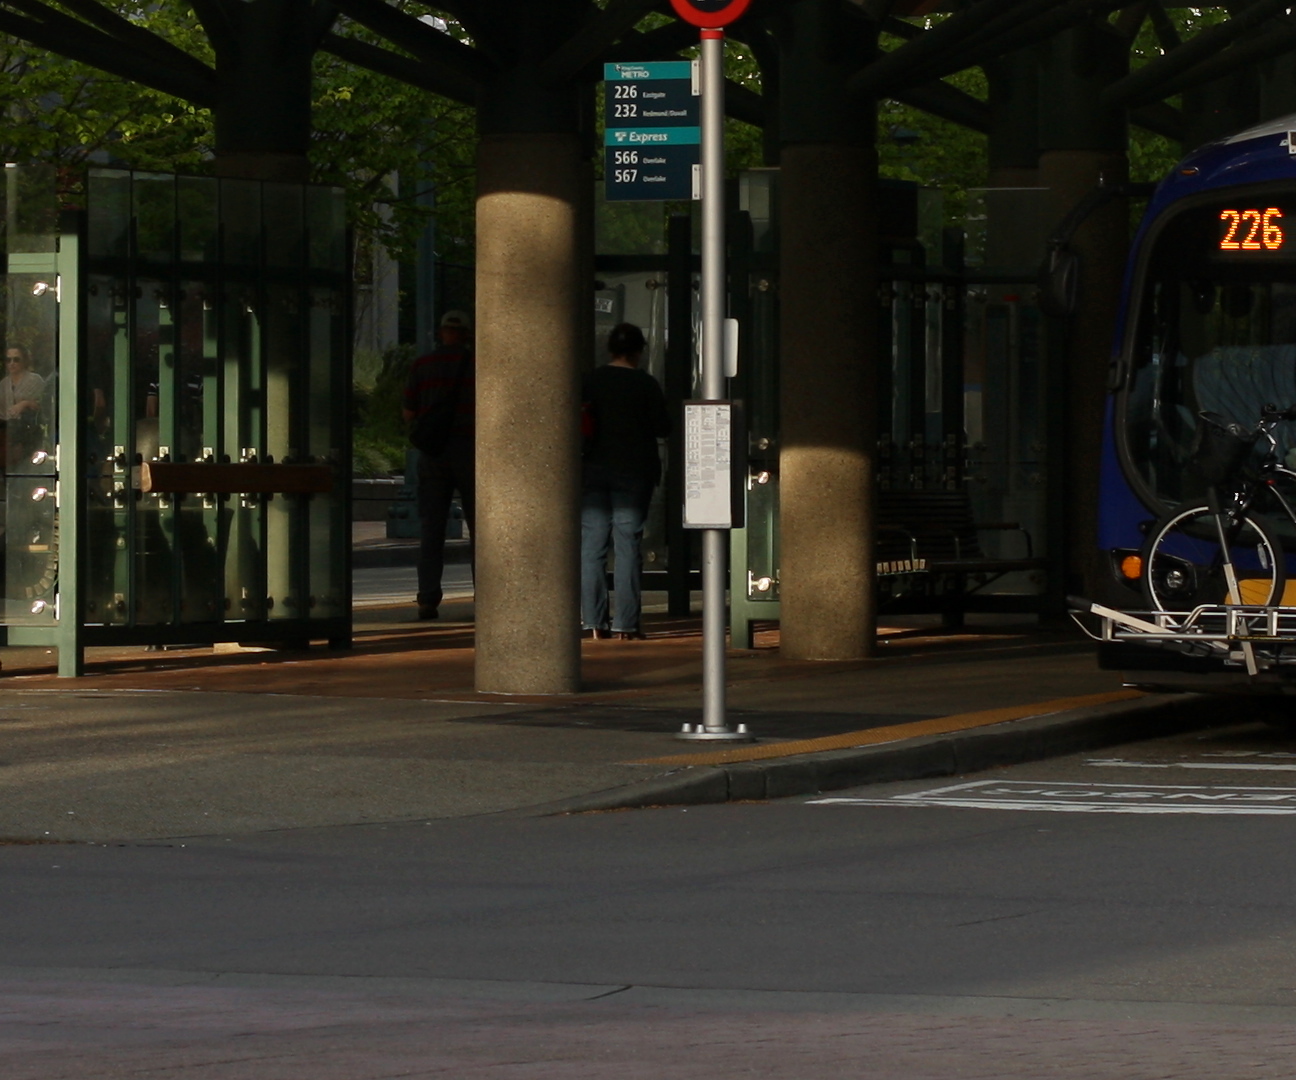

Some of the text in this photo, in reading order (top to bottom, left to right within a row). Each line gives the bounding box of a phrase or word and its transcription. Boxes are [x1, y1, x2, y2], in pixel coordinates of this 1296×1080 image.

[621, 70, 650, 79] METRO
[614, 85, 638, 99] 226
[614, 104, 638, 118] 232
[629, 131, 668, 144] Express
[615, 151, 639, 164] 566
[615, 169, 638, 183] 567
[1220, 207, 1283, 250] 226
